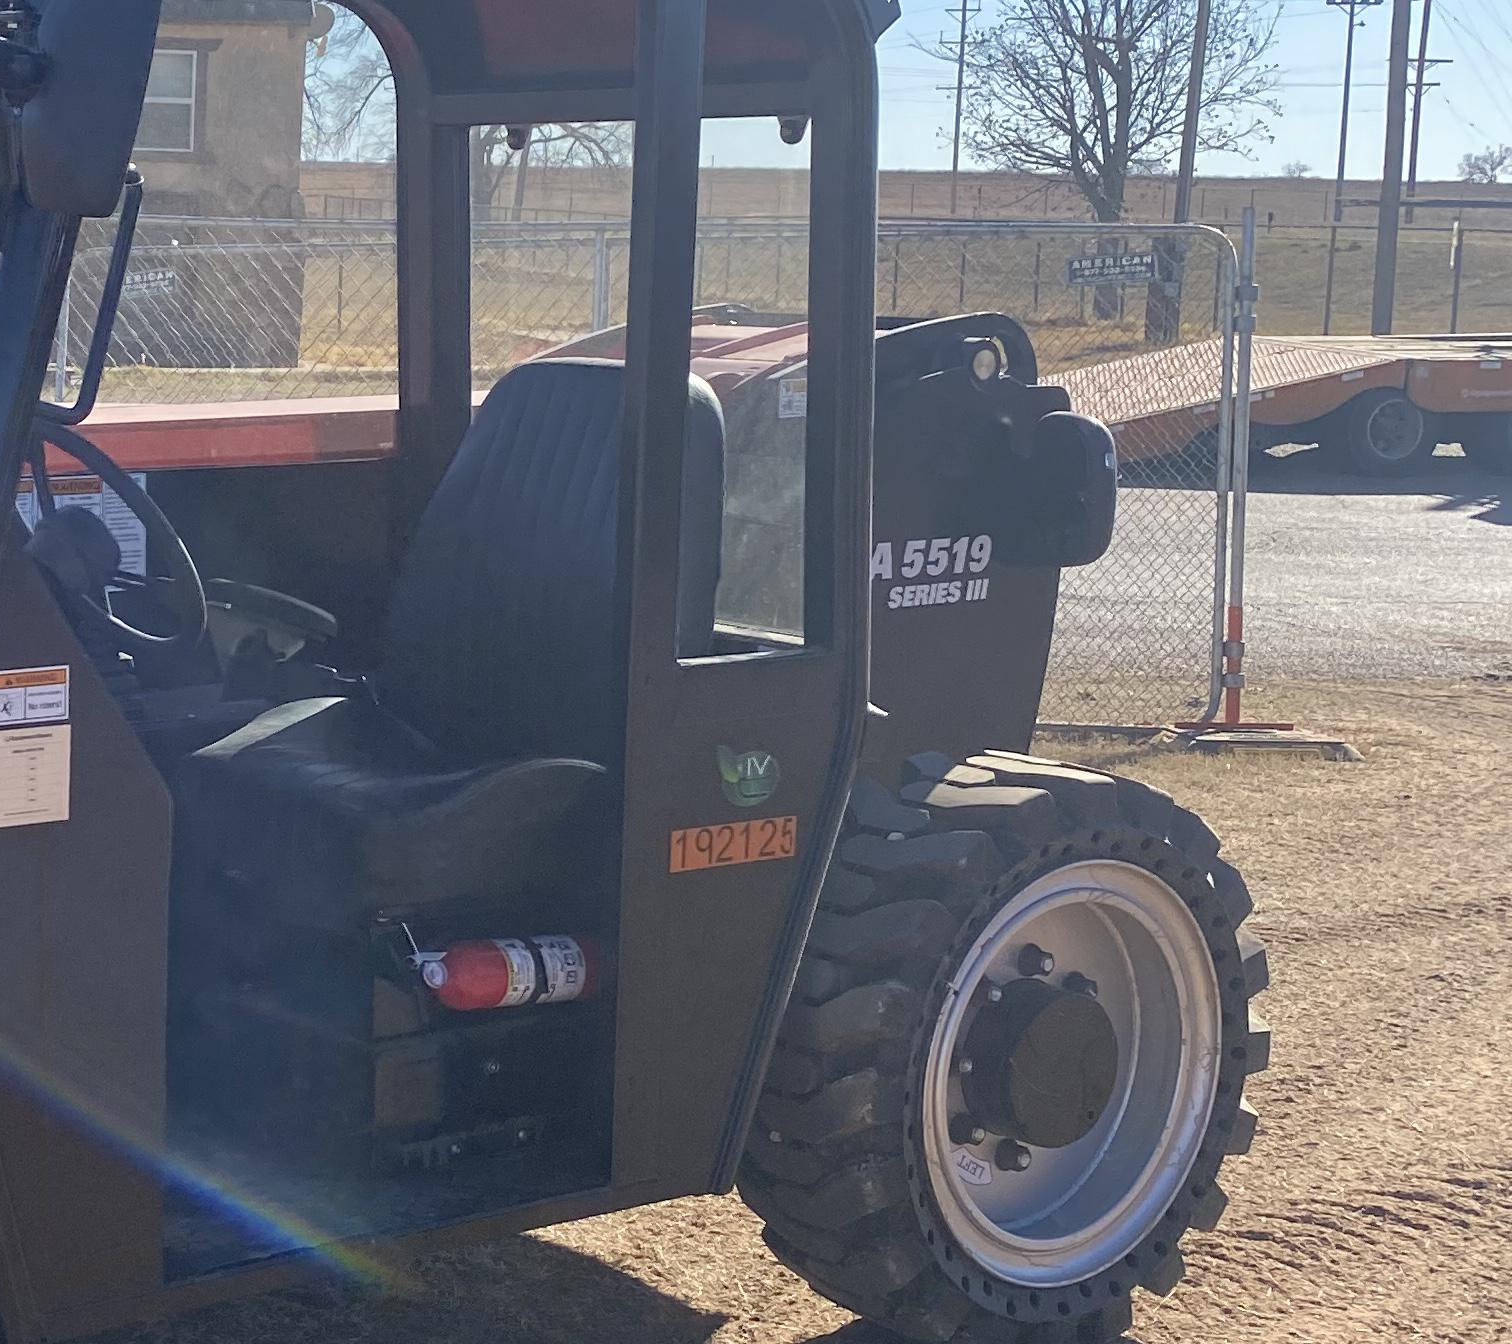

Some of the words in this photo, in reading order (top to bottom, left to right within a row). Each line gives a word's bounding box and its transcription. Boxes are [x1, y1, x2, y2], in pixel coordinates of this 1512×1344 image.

[1072, 255, 1152, 269] AMERICAN
[125, 271, 173, 285] ERICAN
[901, 534, 992, 578] 5519
[888, 580, 962, 609] SERIES
[965, 578, 990, 601] III
[747, 754, 771, 777] IV
[675, 817, 793, 869] 192125
[957, 1154, 985, 1180] LEFT
